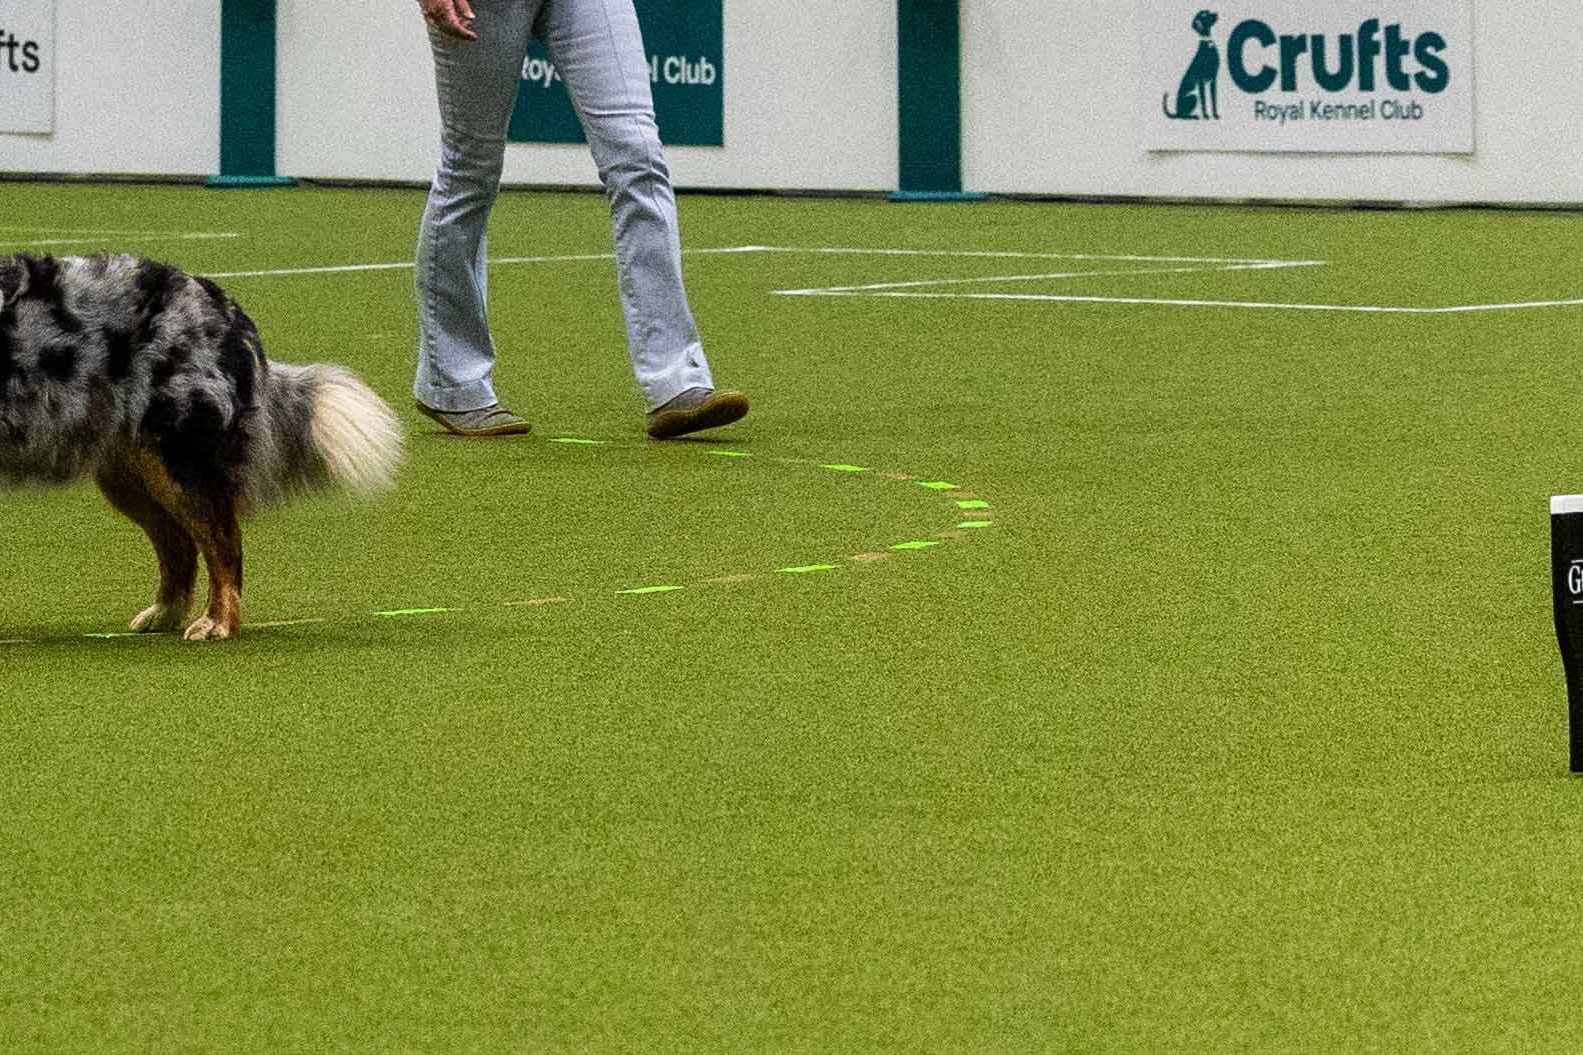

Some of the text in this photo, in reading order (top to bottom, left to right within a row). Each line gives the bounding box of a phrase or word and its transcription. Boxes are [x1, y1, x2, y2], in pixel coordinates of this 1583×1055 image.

[663, 55, 717, 85] Club
[1226, 17, 1451, 94] Crufts
[1253, 99, 1424, 126] Royal Kennel Club
